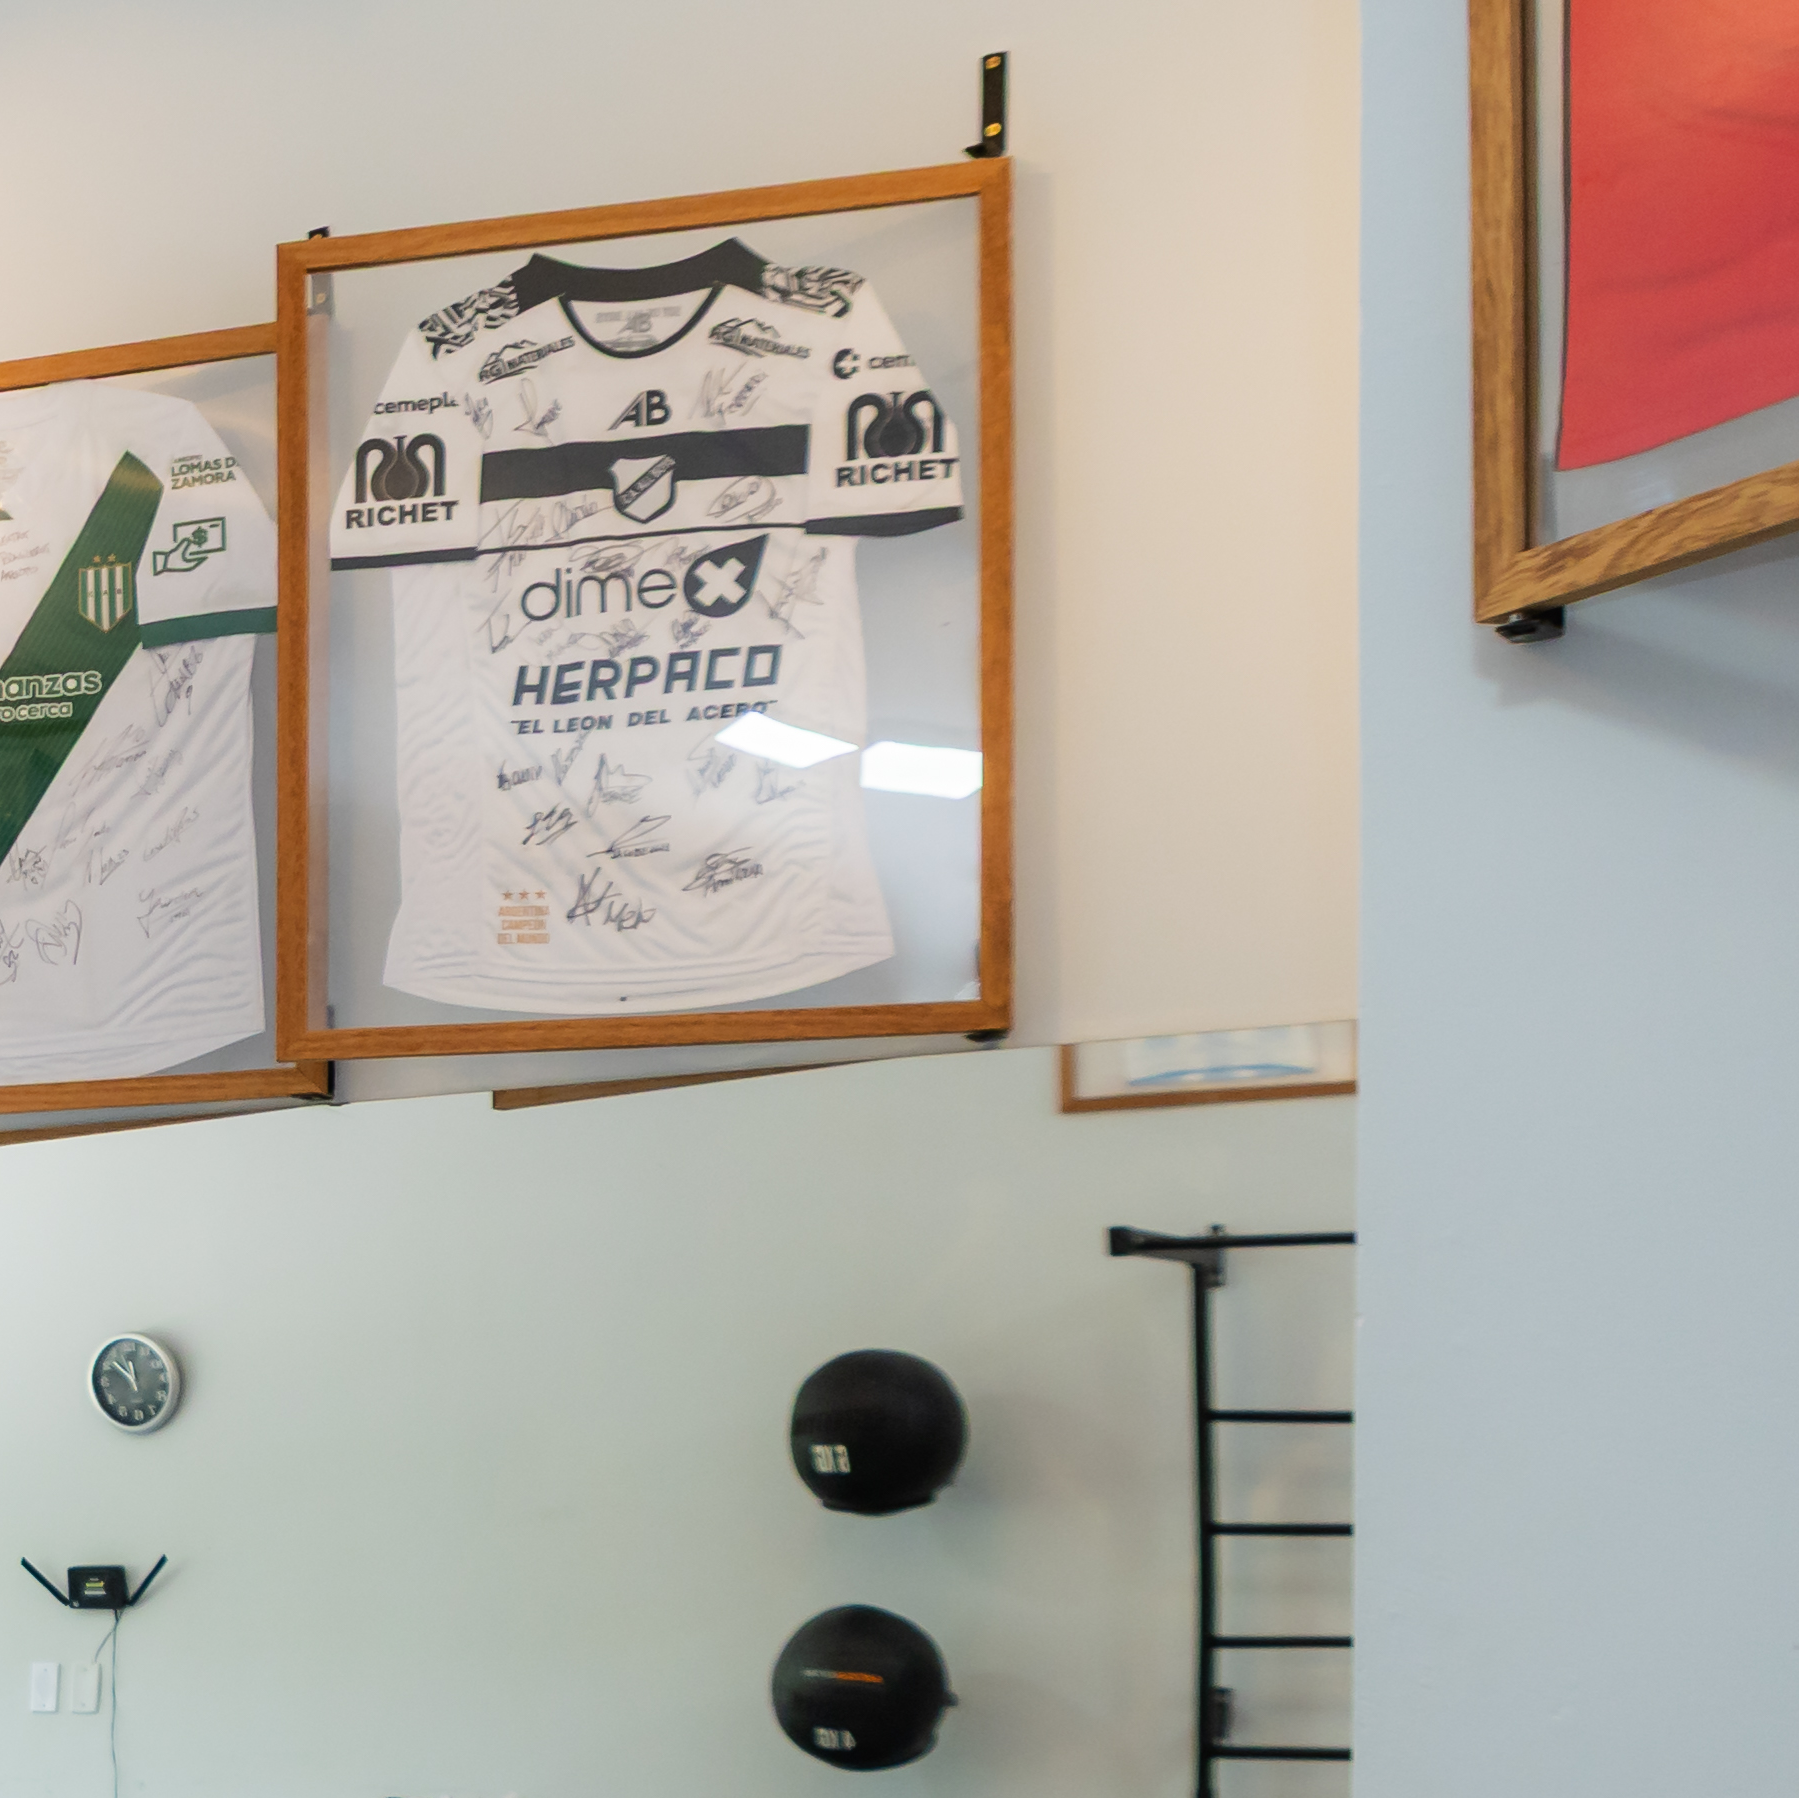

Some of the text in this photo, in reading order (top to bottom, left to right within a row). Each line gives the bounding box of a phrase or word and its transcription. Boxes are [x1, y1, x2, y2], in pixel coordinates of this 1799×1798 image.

[607, 389, 673, 431] AB
[171, 456, 240, 477] LOMAS D
[171, 470, 237, 490] ZAMORA
[835, 458, 960, 488] RICHET
[345, 500, 459, 530] RICHET
[512, 644, 783, 706] HERPACO
[16, 702, 73, 721] cerca
[553, 714, 614, 734] LEON
[627, 709, 671, 727] DEL
